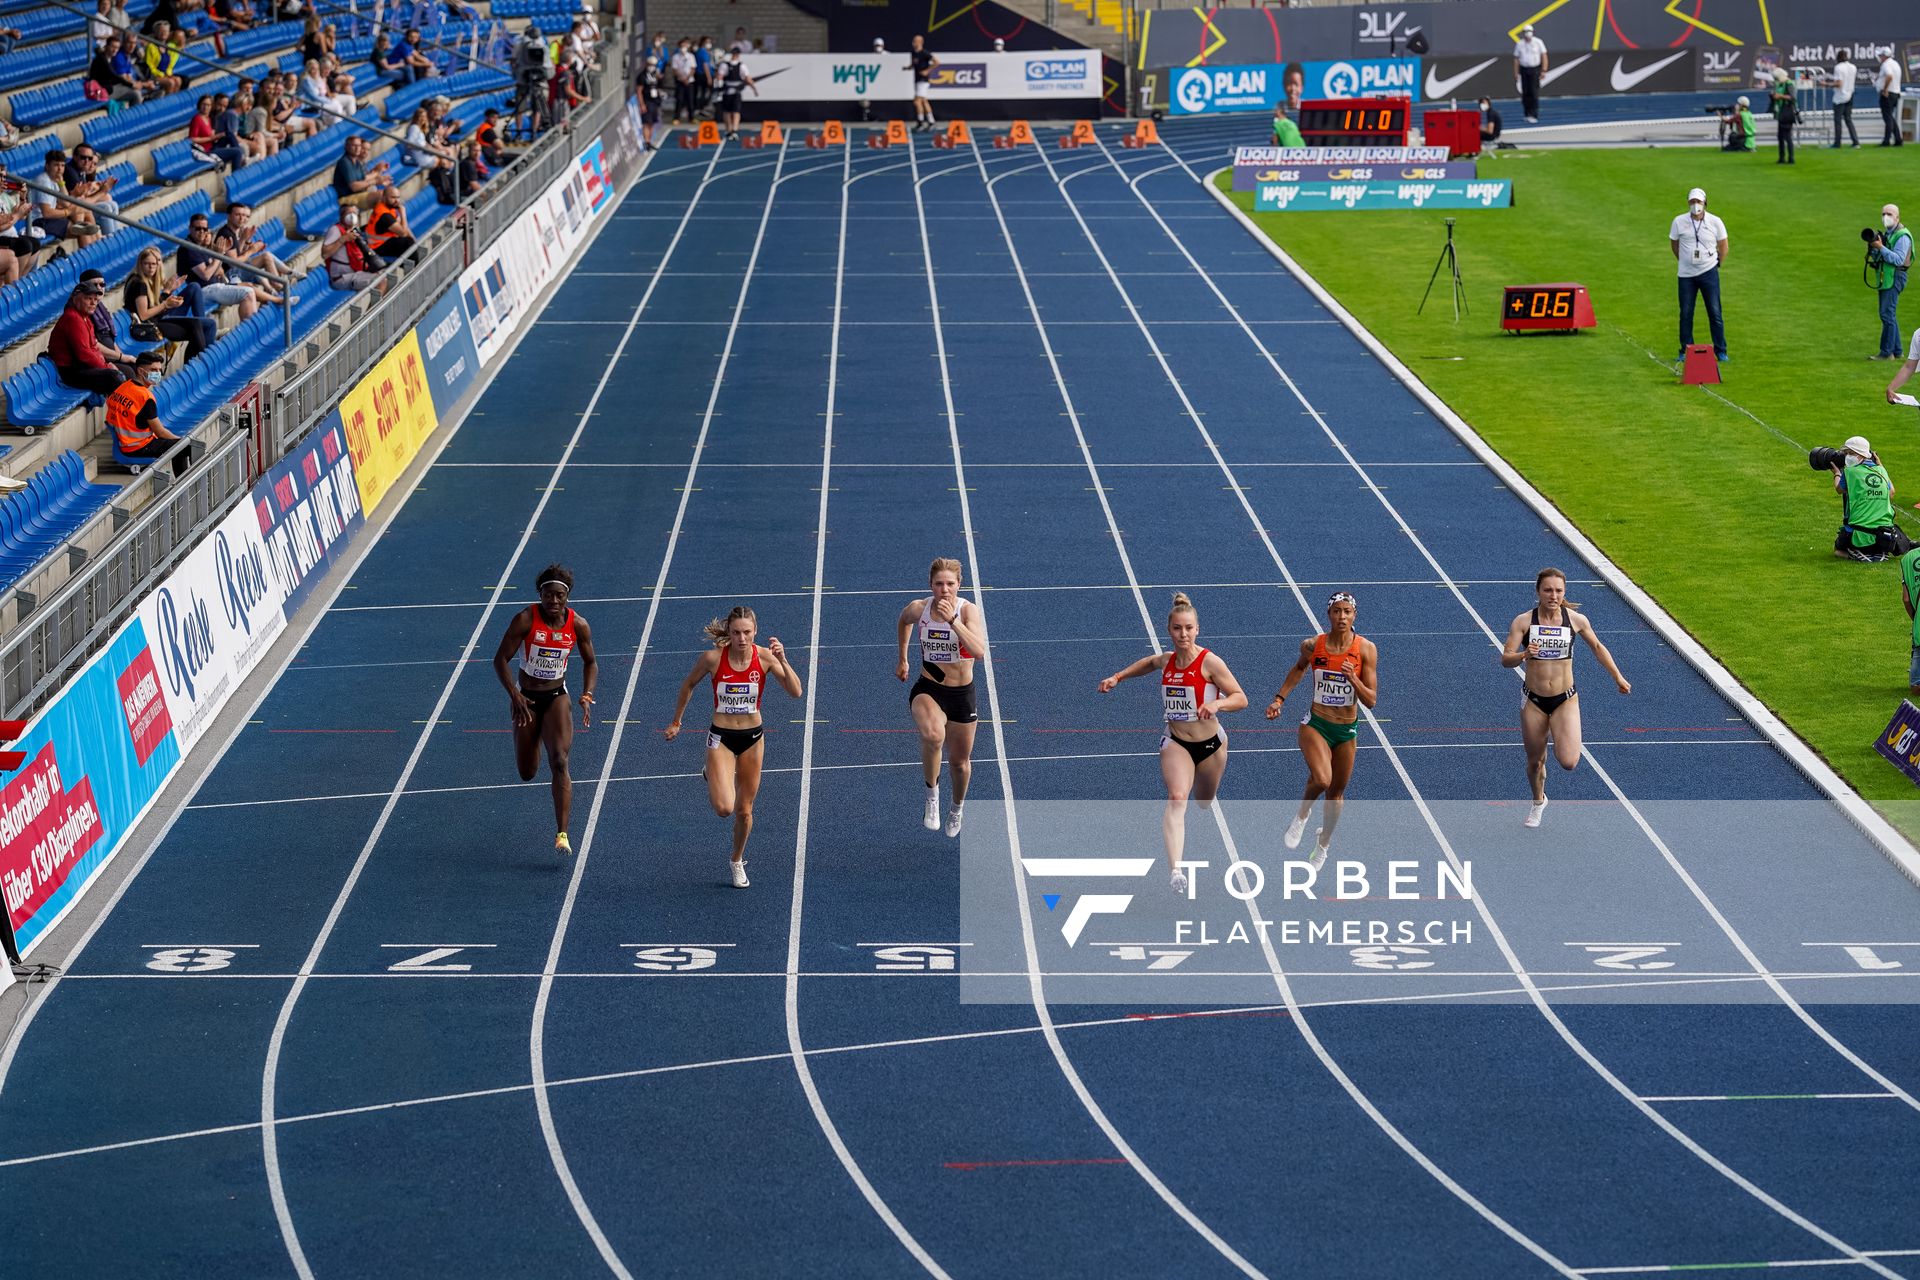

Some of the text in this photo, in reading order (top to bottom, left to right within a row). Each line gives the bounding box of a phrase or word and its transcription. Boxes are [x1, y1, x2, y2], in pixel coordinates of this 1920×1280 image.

[1789, 45, 1823, 62] Jetzt
[1050, 63, 1084, 73] PLAN
[955, 70, 982, 84] GLS
[1215, 71, 1266, 95] PLAN
[1361, 64, 1413, 88] PLAN
[1344, 110, 1392, 130] 11.0
[703, 125, 714, 138] 8
[767, 125, 775, 138] 7
[828, 125, 838, 138] 6
[892, 125, 902, 138] 5
[951, 125, 961, 138] 4
[1016, 125, 1026, 138] 3
[1079, 125, 1089, 138] 2
[1279, 168, 1446, 181] GLS GLS GLS
[1867, 489, 1883, 497] Plan
[214, 531, 267, 636] Reese
[157, 586, 214, 703] Reese
[922, 641, 958, 652] PREPENS
[1317, 681, 1352, 694] PINTO
[719, 696, 756, 706] MONTAG
[1165, 700, 1193, 710] JUNK
[45, 759, 61, 796] in
[4, 865, 34, 914] über
[31, 841, 53, 887] 130
[145, 948, 236, 972] 8
[387, 947, 472, 971] 7
[633, 947, 717, 971] 6
[874, 946, 955, 970] 5
[1348, 946, 1436, 970] 3
[1584, 946, 1676, 969] 2
[1843, 946, 1903, 969] 1
